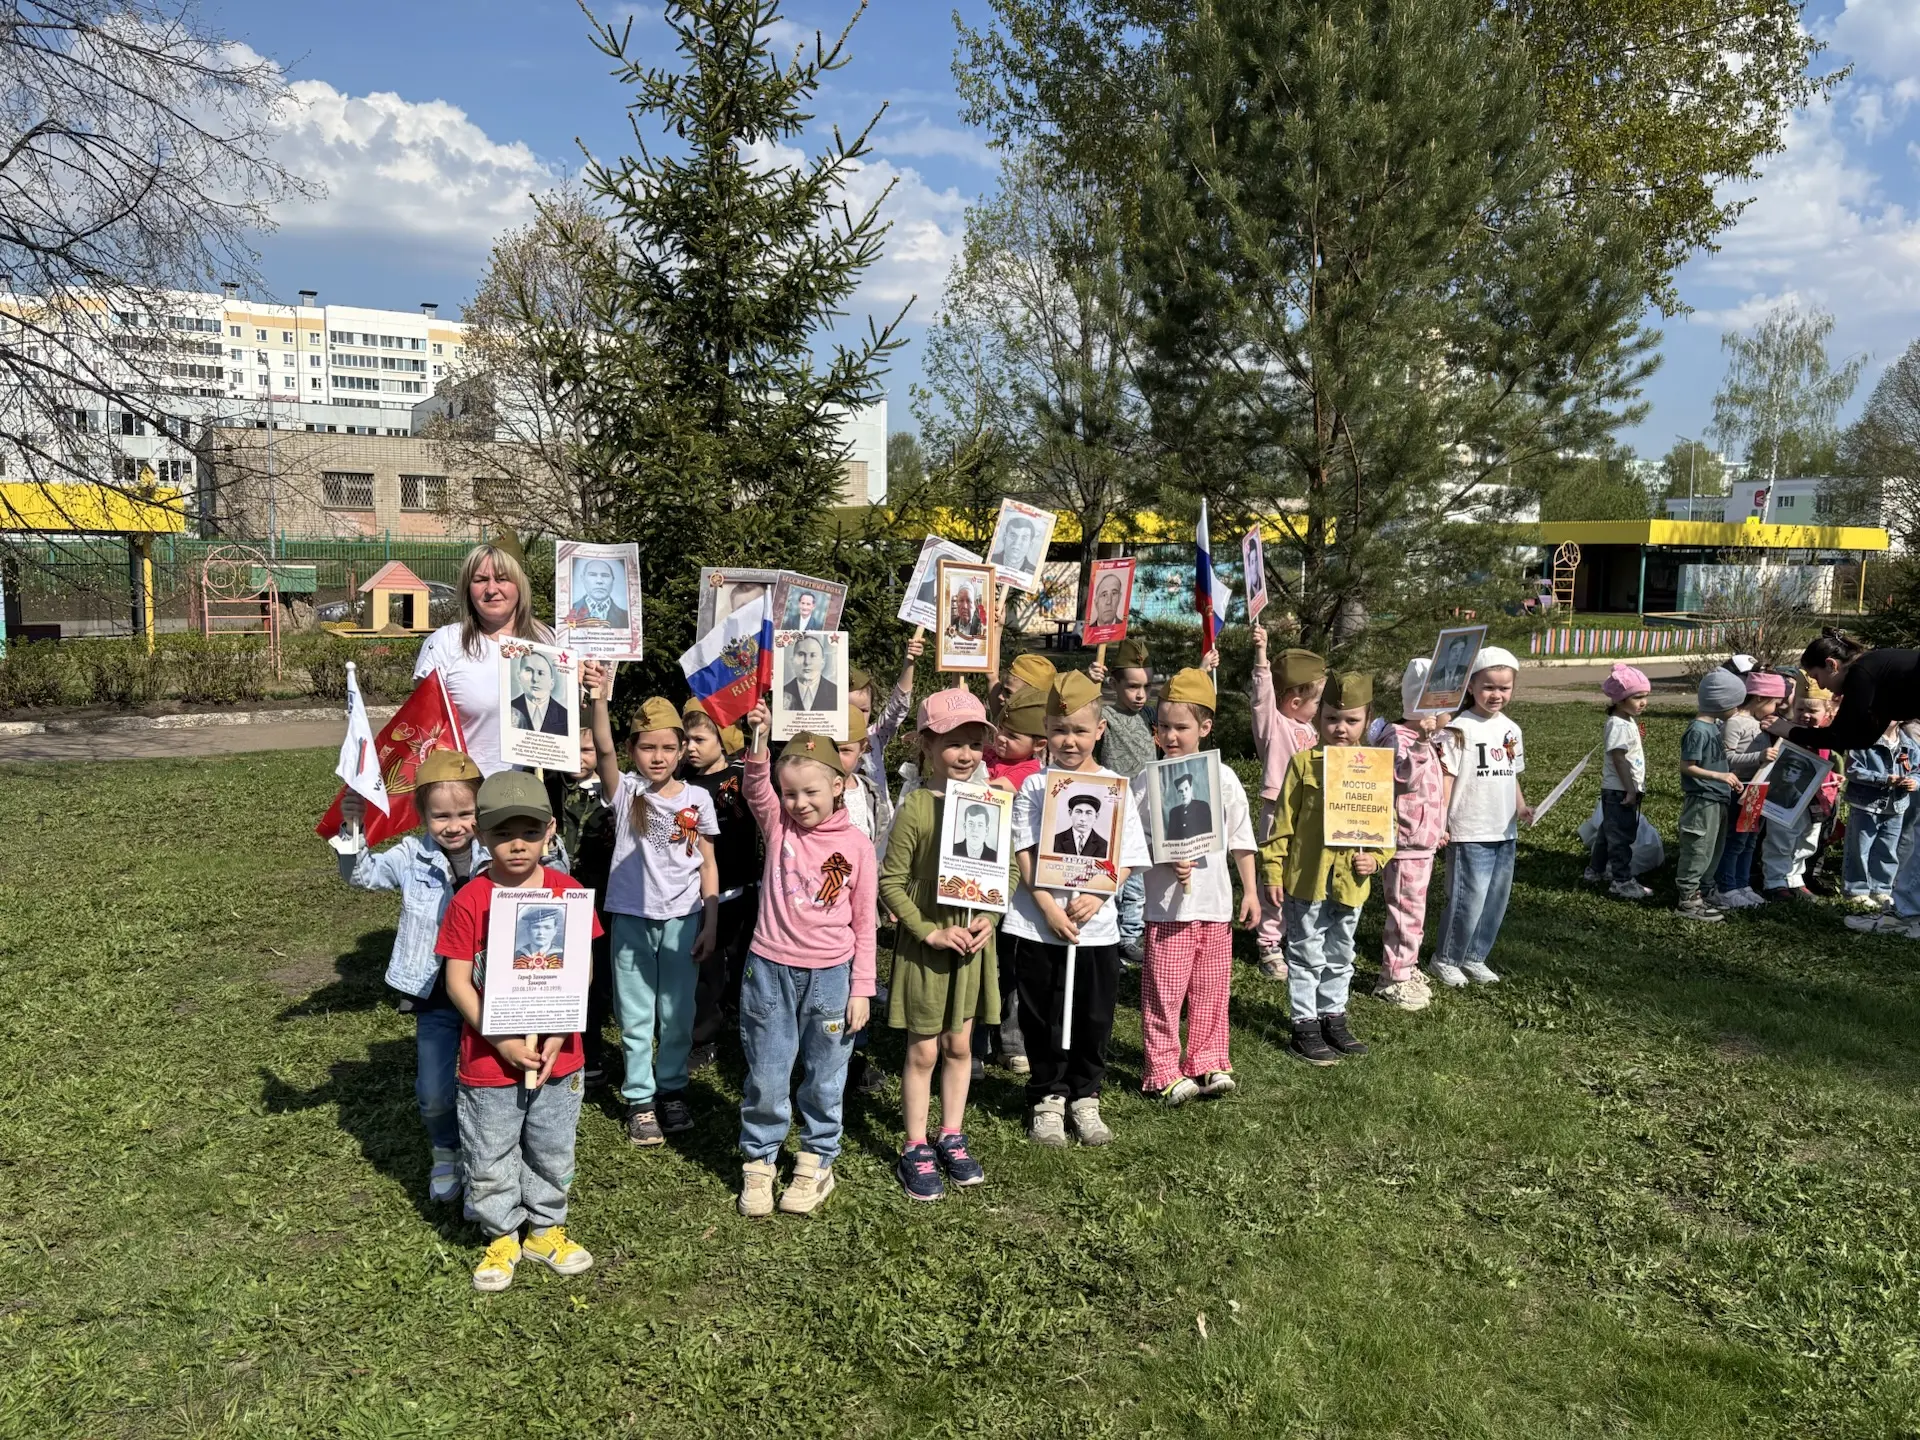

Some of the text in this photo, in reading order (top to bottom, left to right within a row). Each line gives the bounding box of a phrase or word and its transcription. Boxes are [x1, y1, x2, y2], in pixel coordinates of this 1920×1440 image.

[1342, 780, 1377, 790] МОСТОВ
[1345, 792, 1373, 801] ПАВЕЛ
[1329, 802, 1388, 814] ПАНТЕЛЕЕВИЧ
[566, 891, 588, 899] ПОЛК
